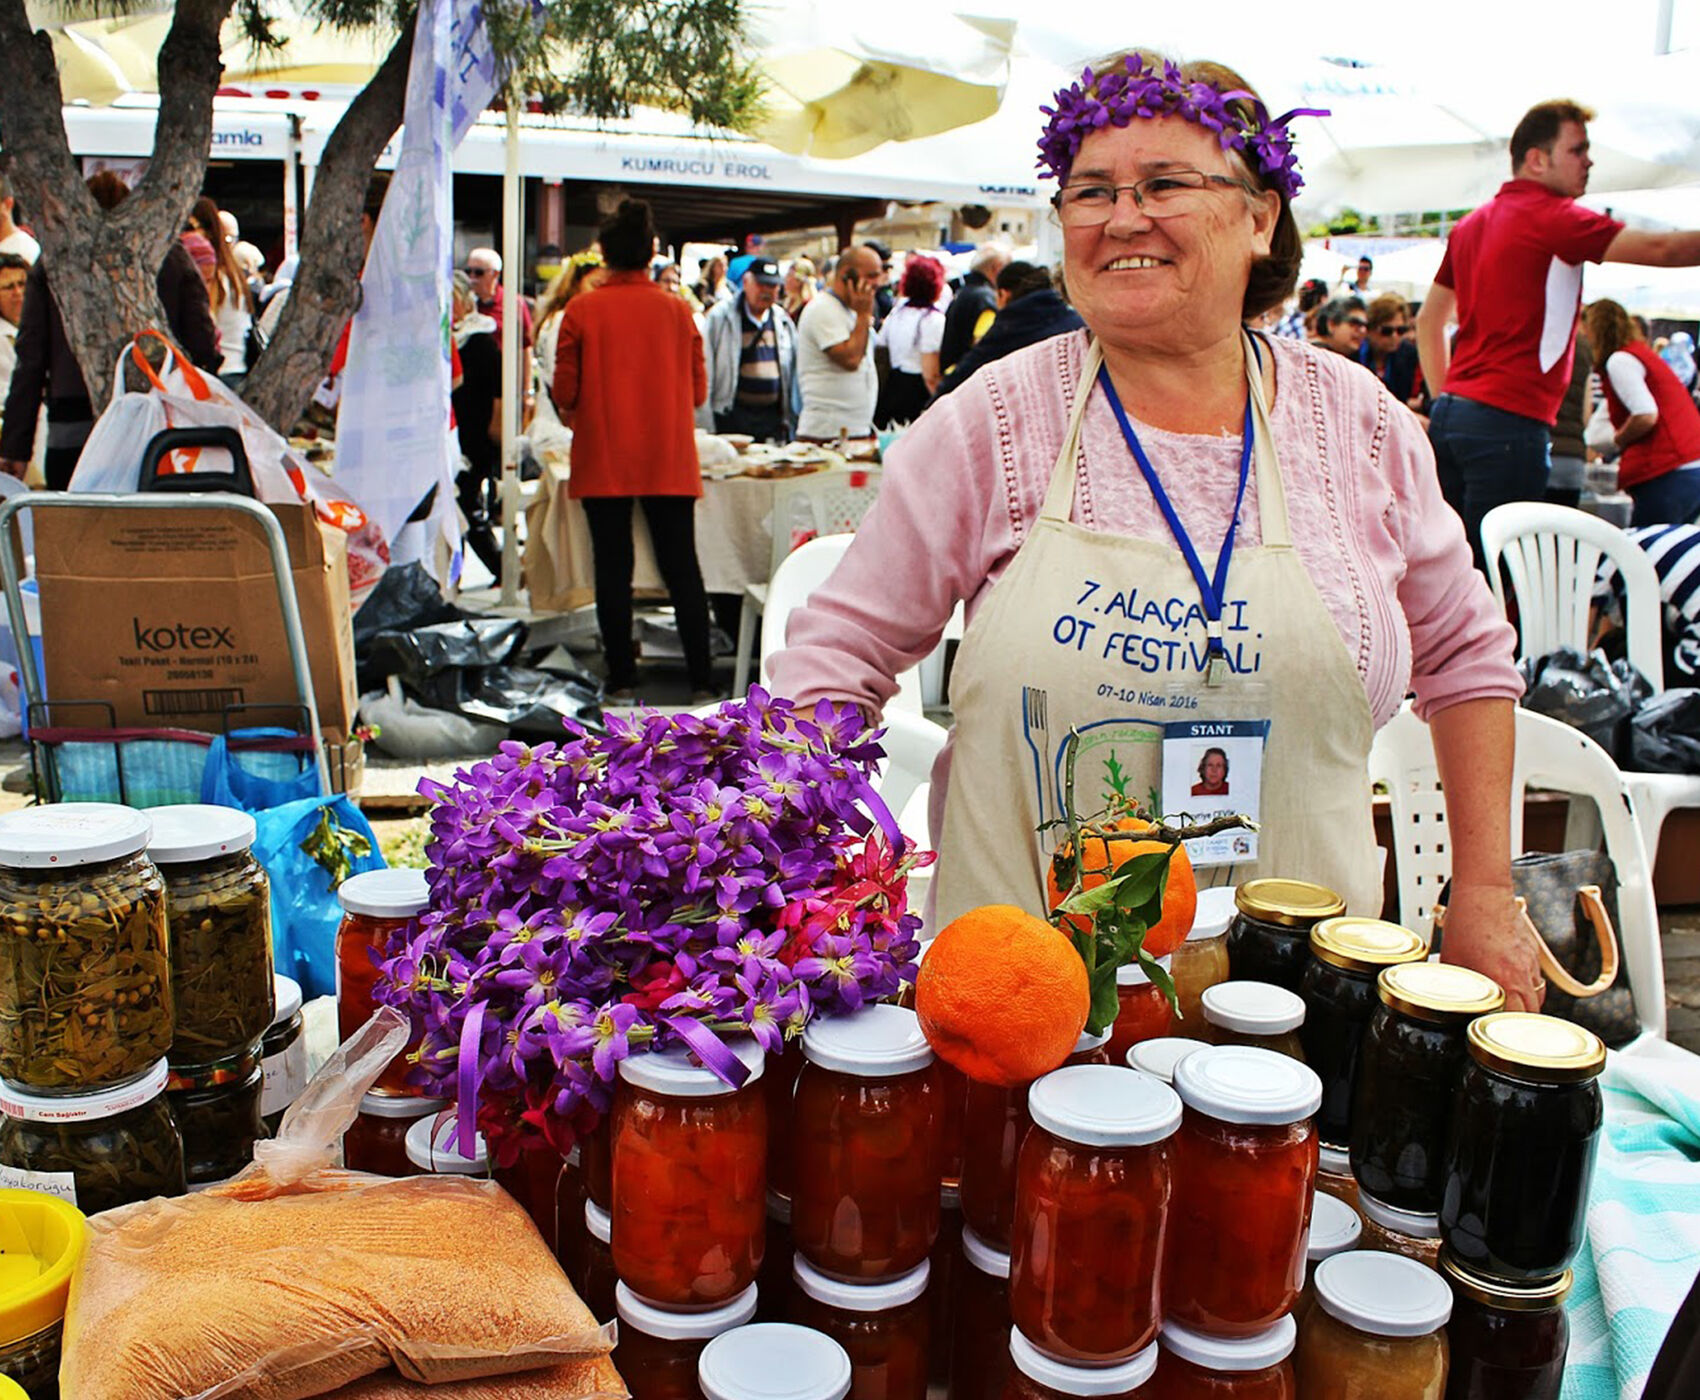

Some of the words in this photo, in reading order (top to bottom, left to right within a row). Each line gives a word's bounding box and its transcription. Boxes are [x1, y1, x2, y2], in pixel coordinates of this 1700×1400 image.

[210, 128, 262, 146] amla
[622, 156, 715, 175] KUMRUCU
[724, 162, 771, 179] EROL
[1104, 588, 1249, 632] ALAÇAI
[133, 617, 235, 652] kotex
[1053, 615, 1096, 651] OT
[1097, 684, 1135, 703] 07-10
[1138, 691, 1166, 707] Nisan
[1170, 694, 1198, 709] 2016
[1191, 725, 1234, 736] STANT
